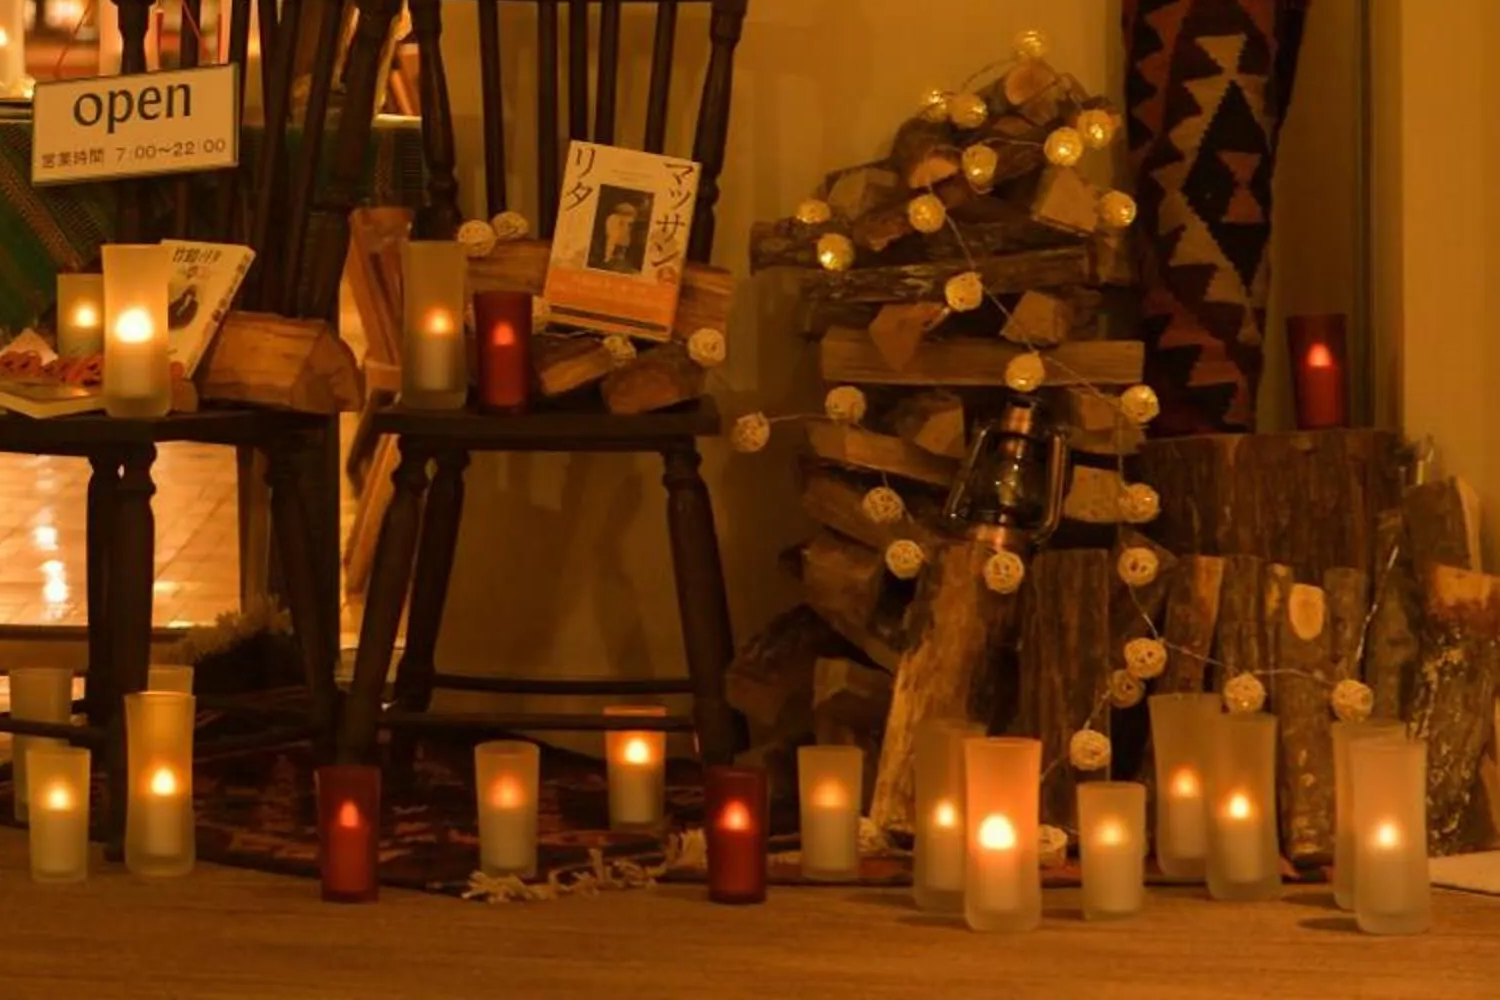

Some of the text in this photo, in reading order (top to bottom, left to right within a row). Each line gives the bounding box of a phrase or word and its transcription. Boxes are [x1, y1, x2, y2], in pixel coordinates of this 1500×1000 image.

[73, 83, 192, 135] open
[41, 147, 105, 168] 営業時間
[565, 147, 596, 211] リタ
